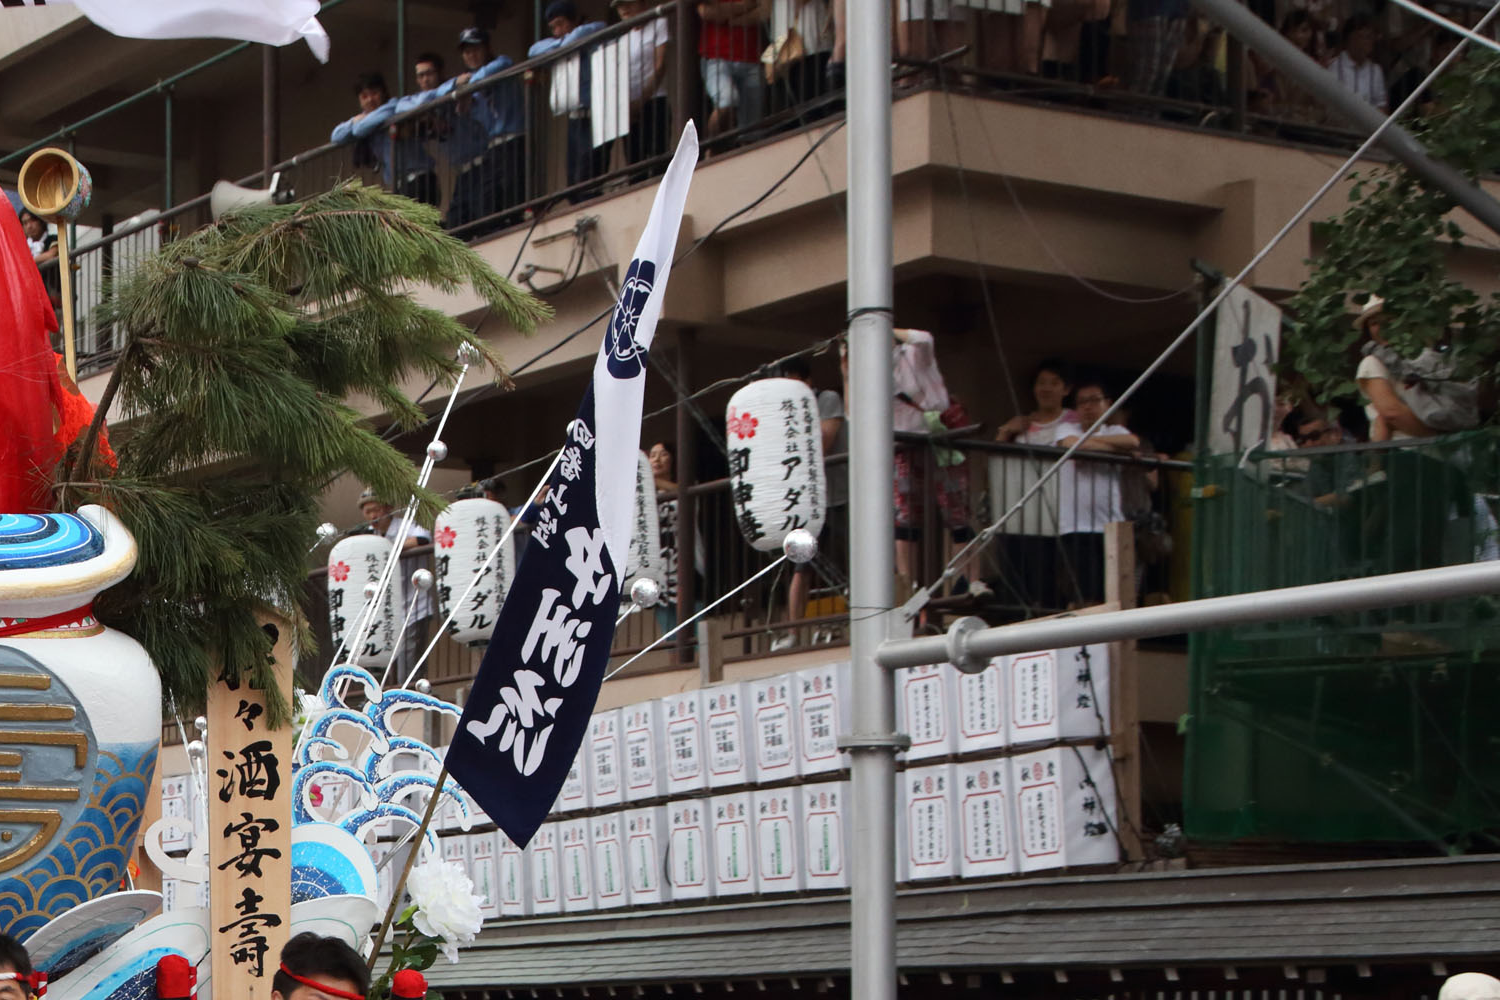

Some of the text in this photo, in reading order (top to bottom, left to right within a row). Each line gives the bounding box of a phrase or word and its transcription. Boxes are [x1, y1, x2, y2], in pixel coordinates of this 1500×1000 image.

[780, 399, 809, 532] 株式会社アダル
[469, 515, 492, 630] 株式会社アダル
